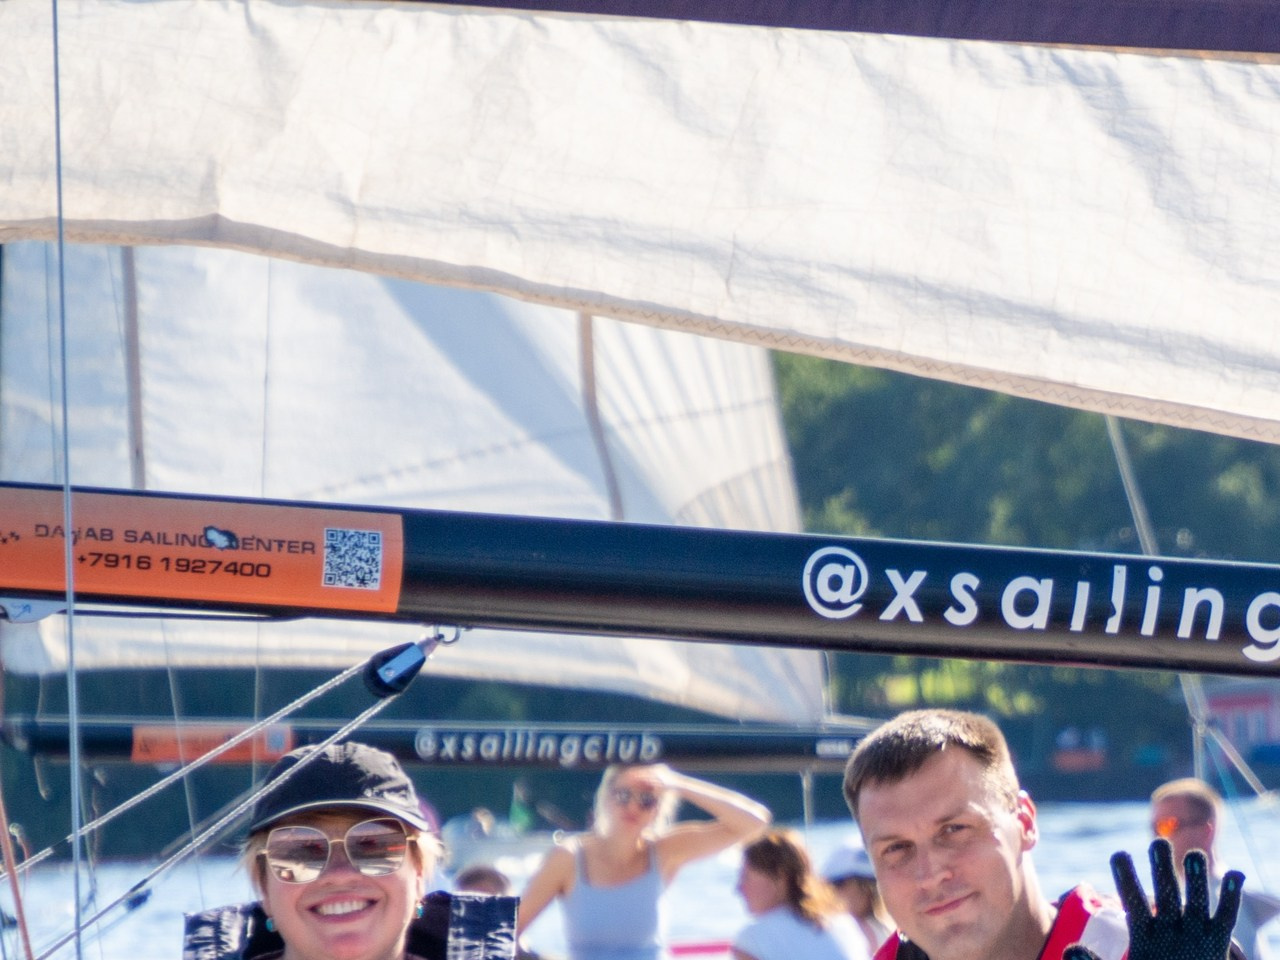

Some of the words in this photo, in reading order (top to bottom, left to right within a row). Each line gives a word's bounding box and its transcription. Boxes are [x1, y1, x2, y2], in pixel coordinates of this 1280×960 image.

[224, 534, 316, 555] ENTER
[77, 551, 152, 571] +7916
[159, 556, 272, 578] 1927400
